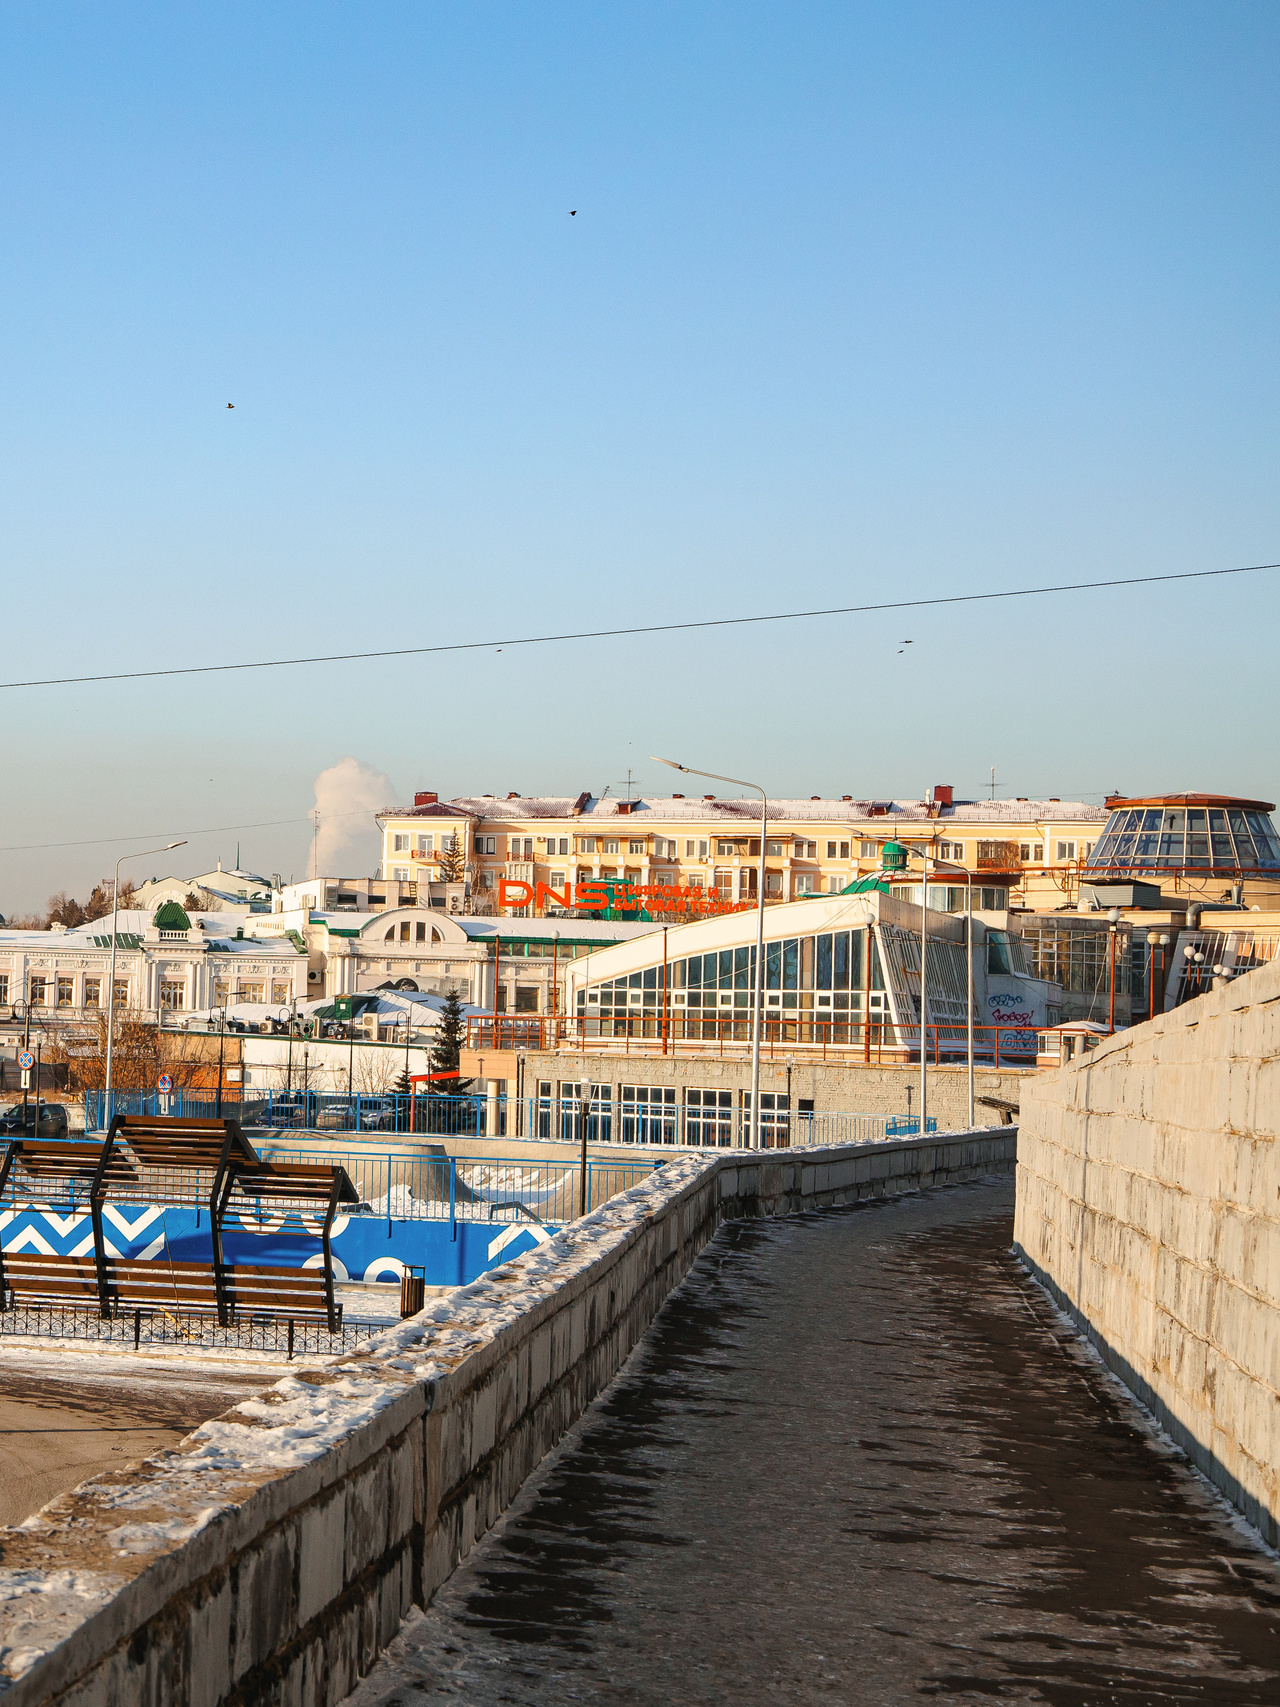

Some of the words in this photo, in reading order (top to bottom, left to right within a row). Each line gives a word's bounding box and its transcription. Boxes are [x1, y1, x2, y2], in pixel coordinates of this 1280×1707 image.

[498, 879, 609, 909] DNS
[614, 883, 702, 898] ЦИФРОВАЯ
[708, 886, 719, 899] И
[614, 898, 686, 912] БЫТОВАЯ
